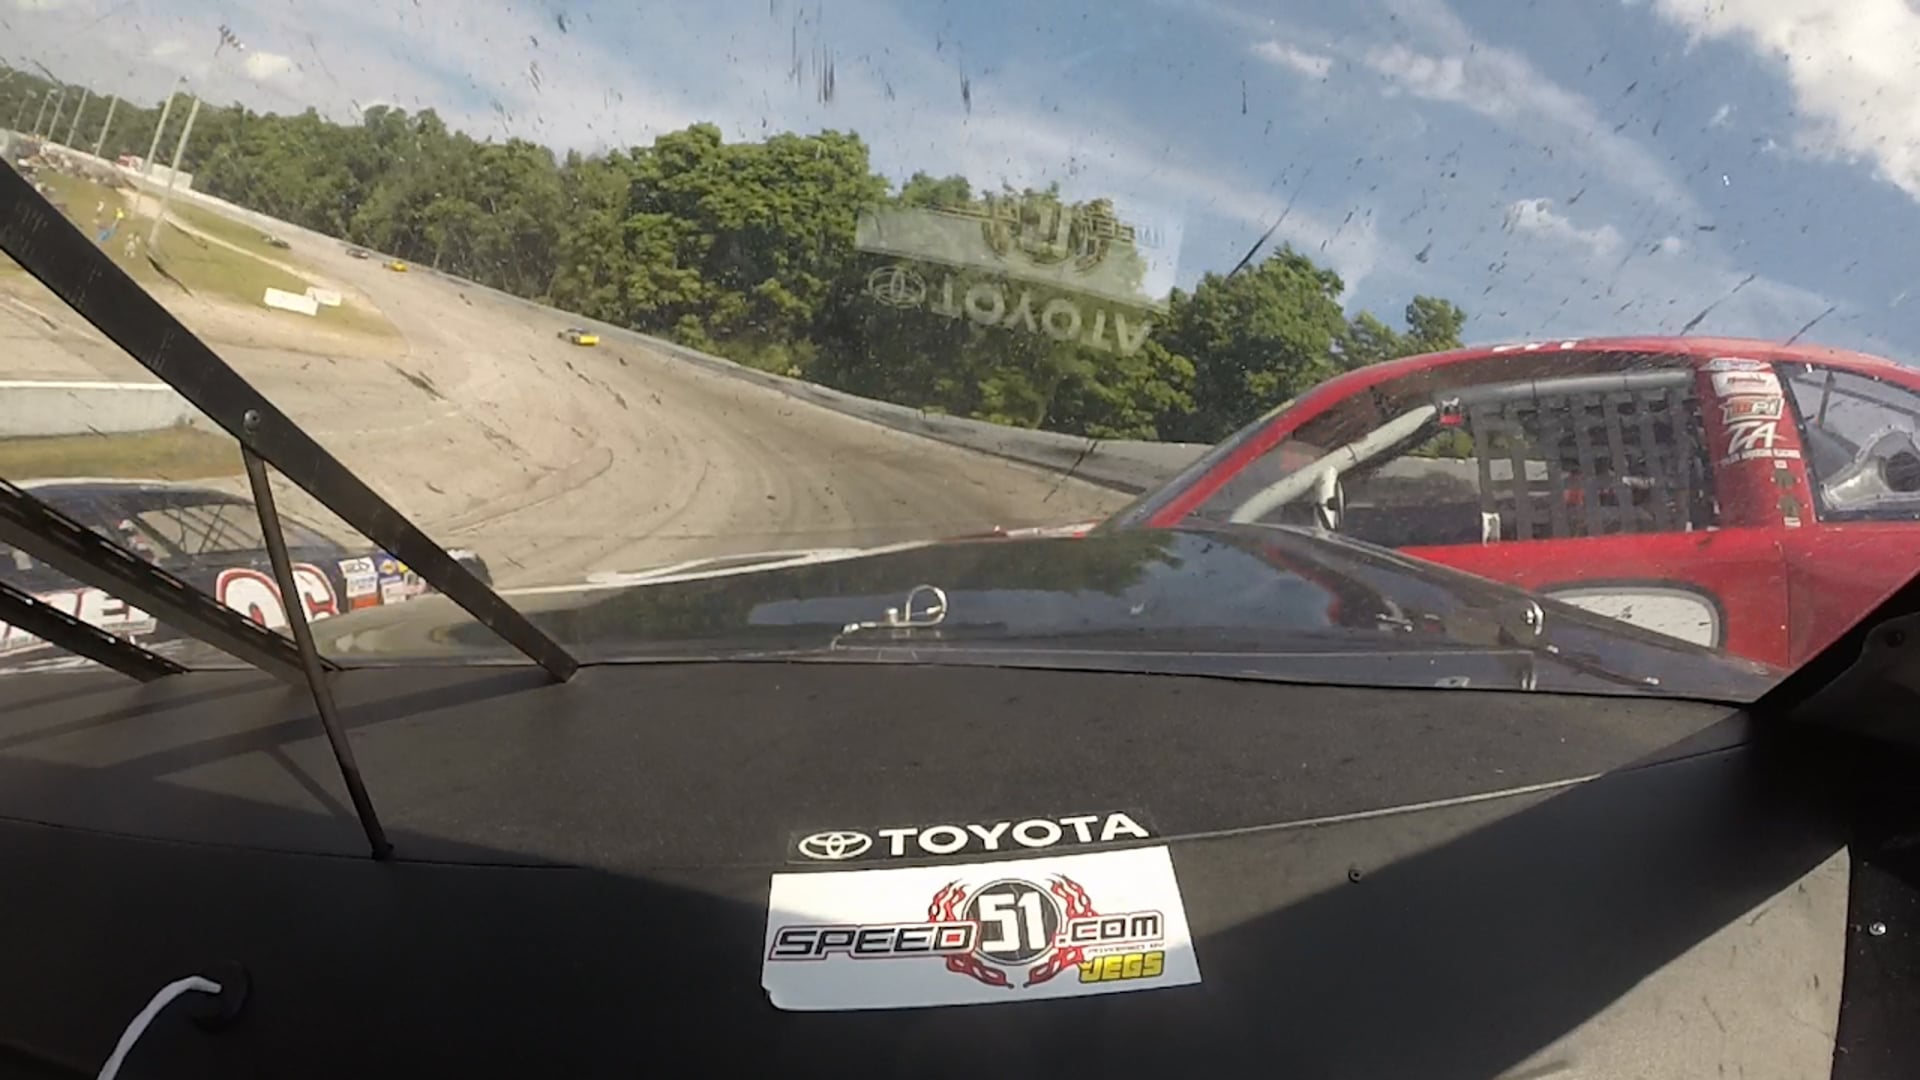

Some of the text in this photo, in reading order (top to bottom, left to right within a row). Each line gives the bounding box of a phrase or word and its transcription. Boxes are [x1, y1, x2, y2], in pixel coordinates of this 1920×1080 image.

[878, 812, 1149, 857] TOYOTA
[773, 924, 977, 957] SPEED
[978, 891, 1047, 953] 51
[1079, 951, 1164, 983] JEGS
